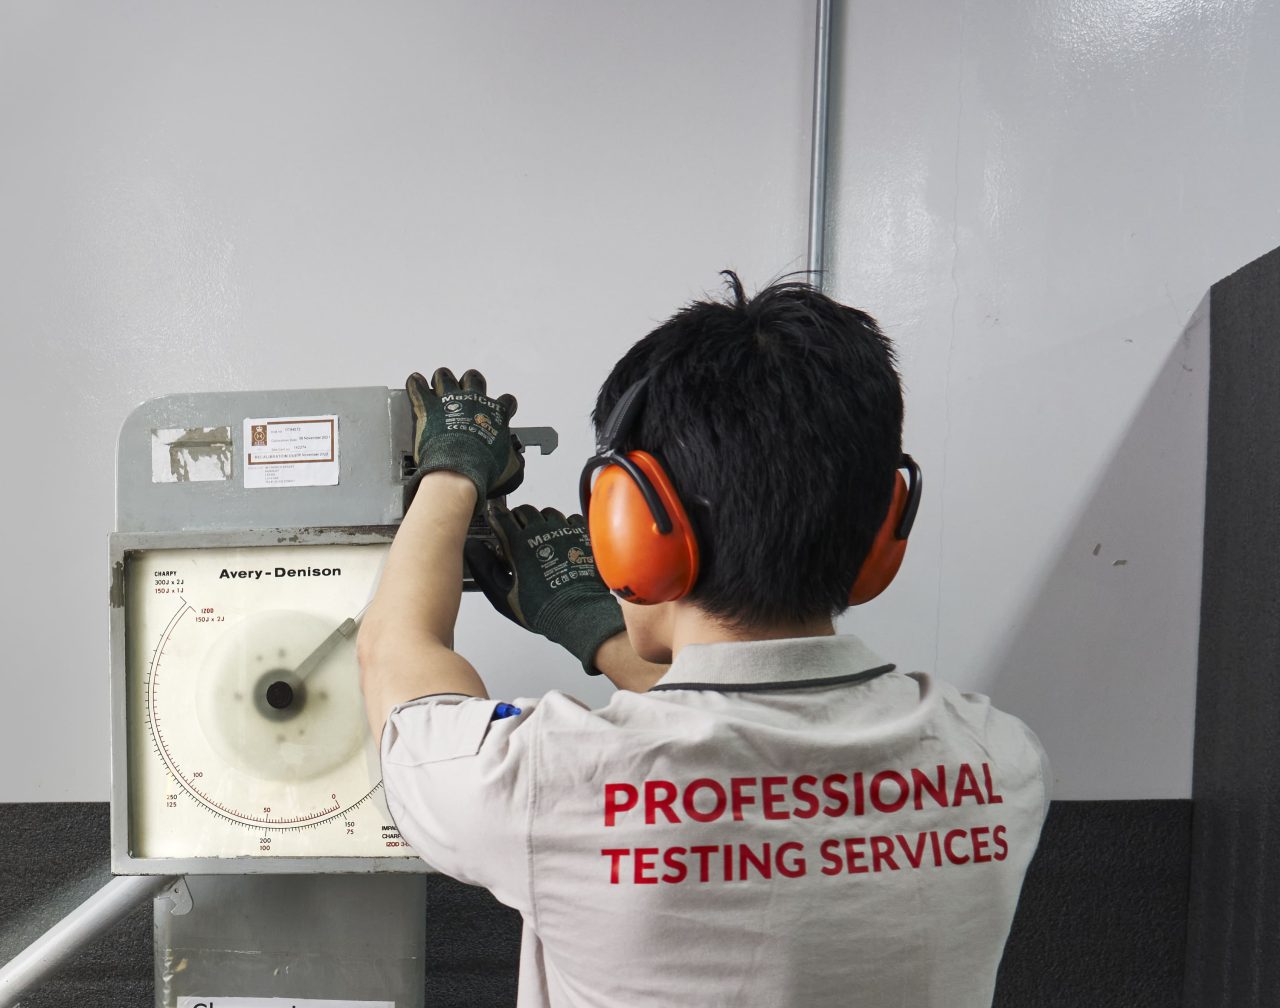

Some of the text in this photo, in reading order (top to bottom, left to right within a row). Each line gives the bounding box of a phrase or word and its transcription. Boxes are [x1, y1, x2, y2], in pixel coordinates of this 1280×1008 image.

[442, 394, 501, 412] MaxiCut
[528, 528, 584, 548] MaxiCut
[604, 762, 1003, 827] PROFESSIONAL
[601, 824, 1008, 885] TESTING SERVICES
